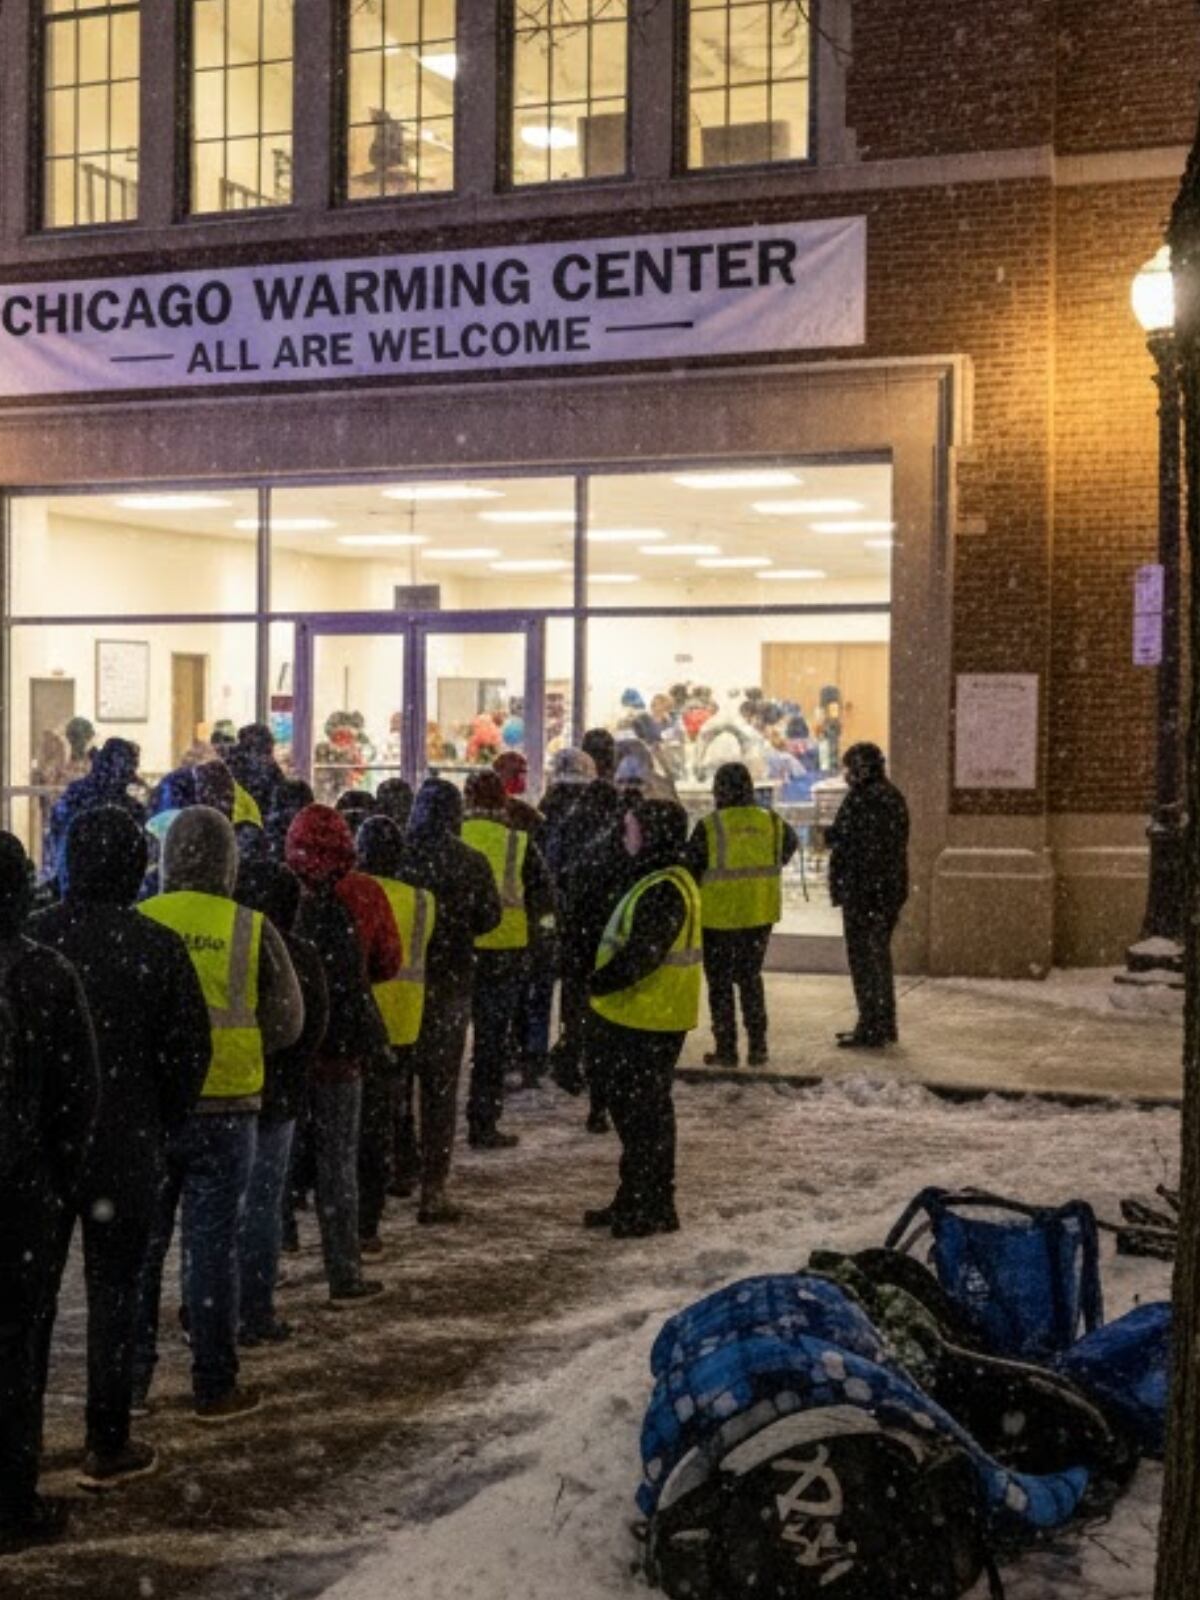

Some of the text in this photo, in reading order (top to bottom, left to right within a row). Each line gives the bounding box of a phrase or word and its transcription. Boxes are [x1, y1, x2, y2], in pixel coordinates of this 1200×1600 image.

[2, 238, 798, 336] CHICAGO WARMING CENTER
[186, 316, 591, 374] ALL ARE WELCOME
